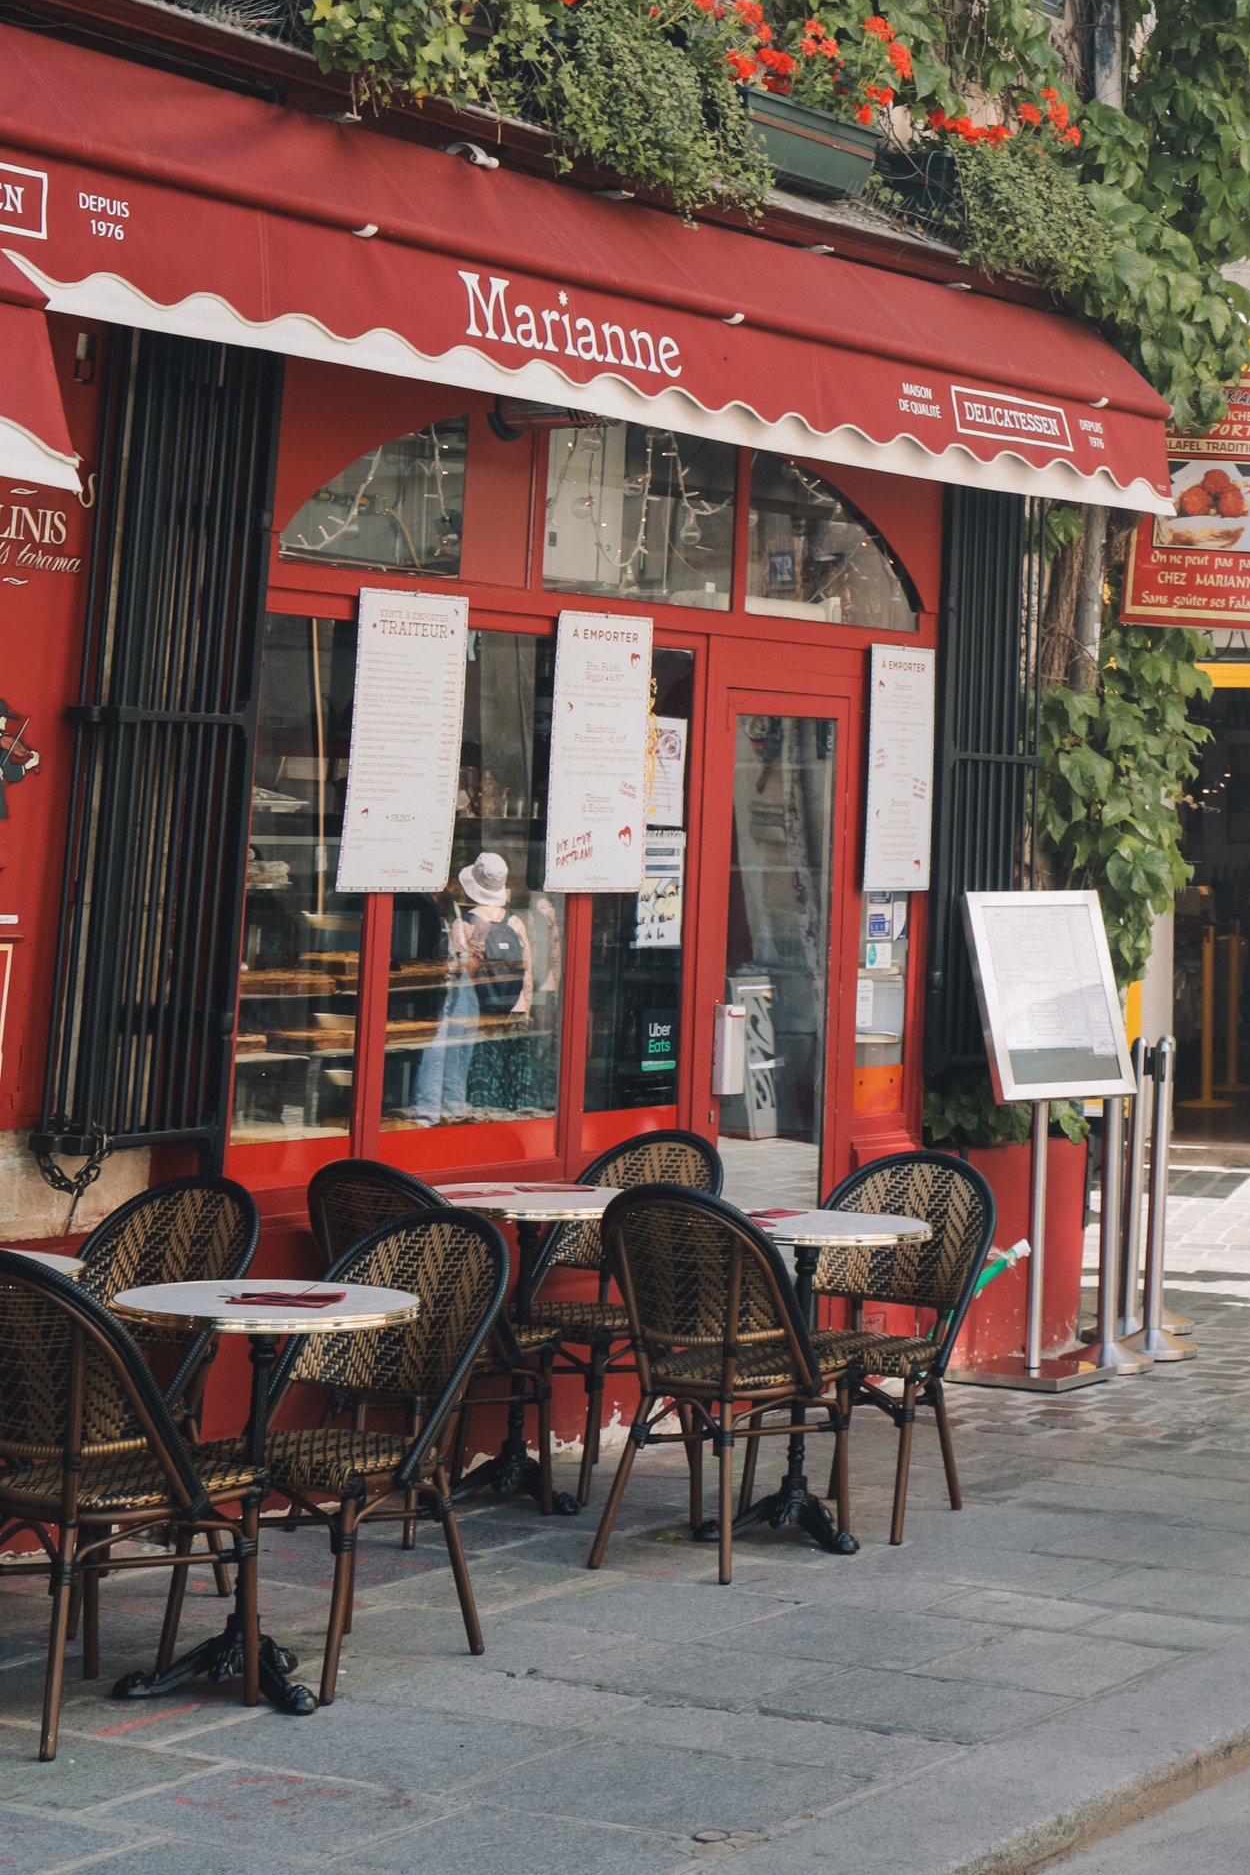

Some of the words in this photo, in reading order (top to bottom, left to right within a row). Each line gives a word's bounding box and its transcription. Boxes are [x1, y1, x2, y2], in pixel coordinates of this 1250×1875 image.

[79, 192, 129, 218] DEPUIS
[90, 219, 124, 240] 1976
[458, 270, 682, 378] Marianne
[902, 382, 932, 400] MAISON
[898, 398, 911, 413] DE
[911, 400, 942, 419] QUALITÉ
[963, 401, 1061, 437] DELICATESSEN
[1079, 419, 1104, 434] DEPUIS
[1088, 436, 1105, 449] 1976
[1166, 440, 1201, 451] LAFEL
[0, 504, 67, 545] LINIS
[16, 543, 82, 573] tarama
[1151, 550, 1167, 563] On
[1170, 554, 1182, 563] ne
[1184, 554, 1209, 568] peut
[1214, 557, 1233, 570] pas
[1157, 571, 1187, 585] CHEZ
[1141, 590, 1168, 605] Sans
[1173, 593, 1206, 609] goûter
[1210, 598, 1226, 607] ses
[380, 619, 448, 639] TRAITEUR
[583, 628, 639, 643] EMPORTER
[888, 660, 926, 673] EMPORTER
[555, 846, 594, 868] PASTRAMI
[649, 1023, 671, 1037] Uber
[648, 1039, 671, 1054] Eats
